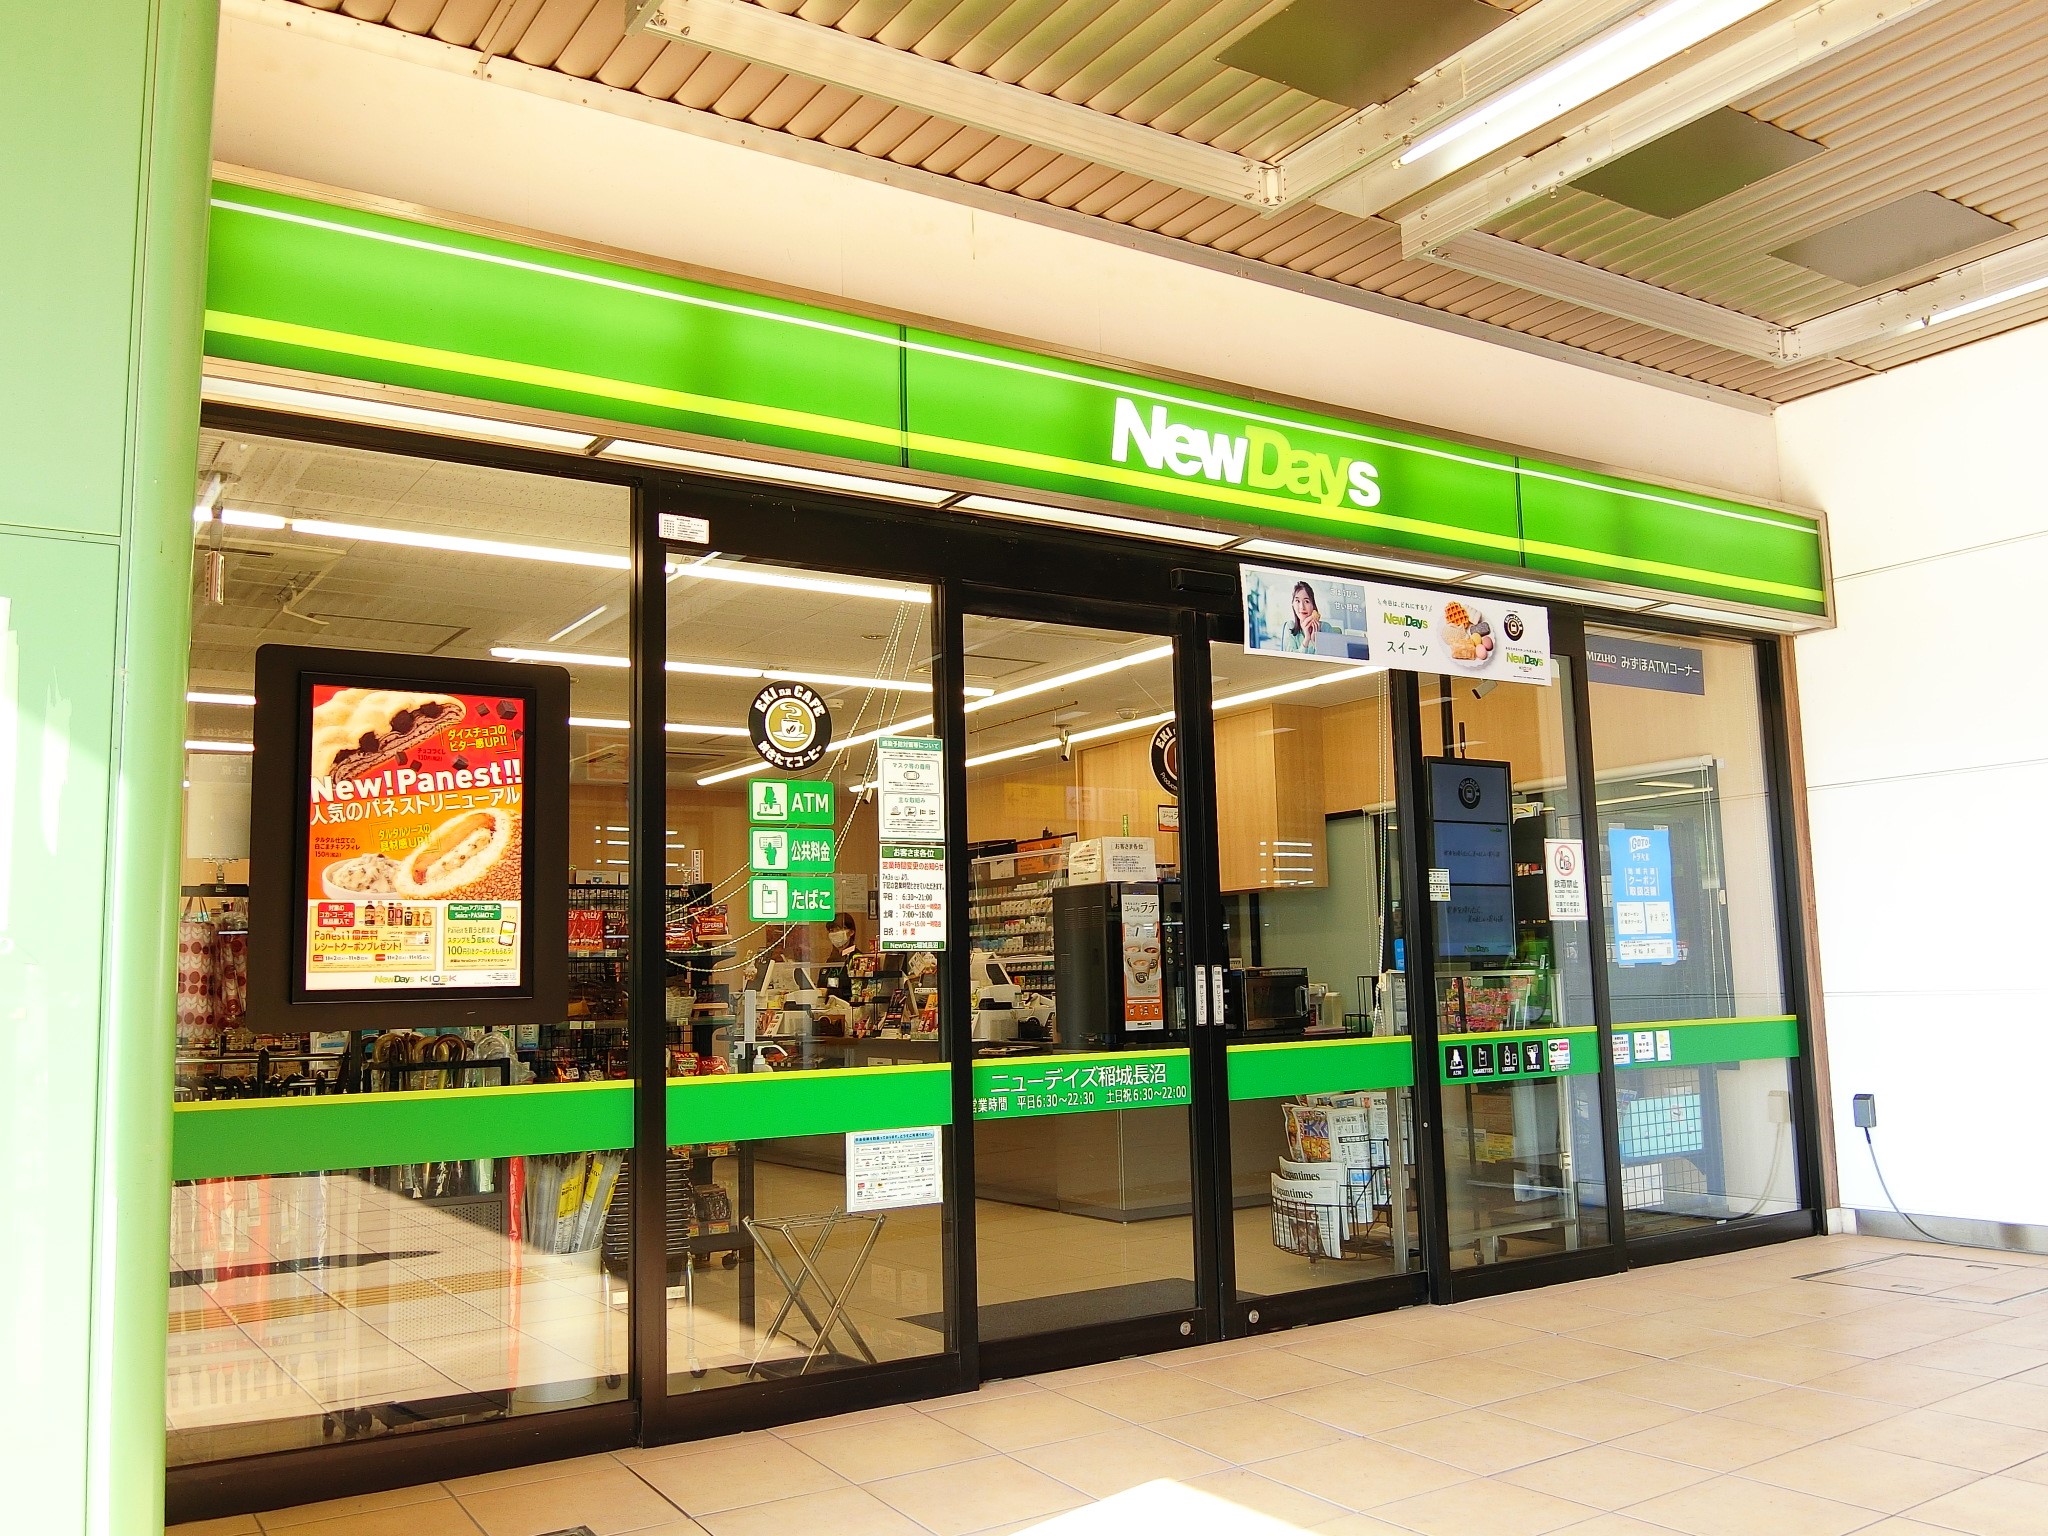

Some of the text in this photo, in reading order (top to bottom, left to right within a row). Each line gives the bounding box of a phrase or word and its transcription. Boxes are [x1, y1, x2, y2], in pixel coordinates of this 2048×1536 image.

[1112, 397, 1381, 508] NewDays
[1383, 612, 1428, 629] NewDays
[1387, 641, 1429, 657] スイーツ
[1506, 652, 1544, 667] NewDays
[1621, 655, 1700, 676] みずほATMコーナー
[754, 684, 826, 717] EKI na CAFE
[448, 724, 507, 740] ダイスチョコの
[450, 736, 508, 752] ビター感UP!!
[310, 786, 521, 826] 人気のパネストリニューアル
[792, 793, 829, 813] ATM
[378, 824, 431, 839] タルタルソースの
[791, 840, 831, 862] 公共料金
[894, 849, 934, 858] お客さま各位
[882, 862, 944, 870] 営業時間変更のお知らせ
[1628, 876, 1656, 886] クーポン
[791, 889, 831, 910] たばこ
[374, 975, 414, 983] NewDays
[990, 1064, 1166, 1093] ニューデイズ稲城長沼
